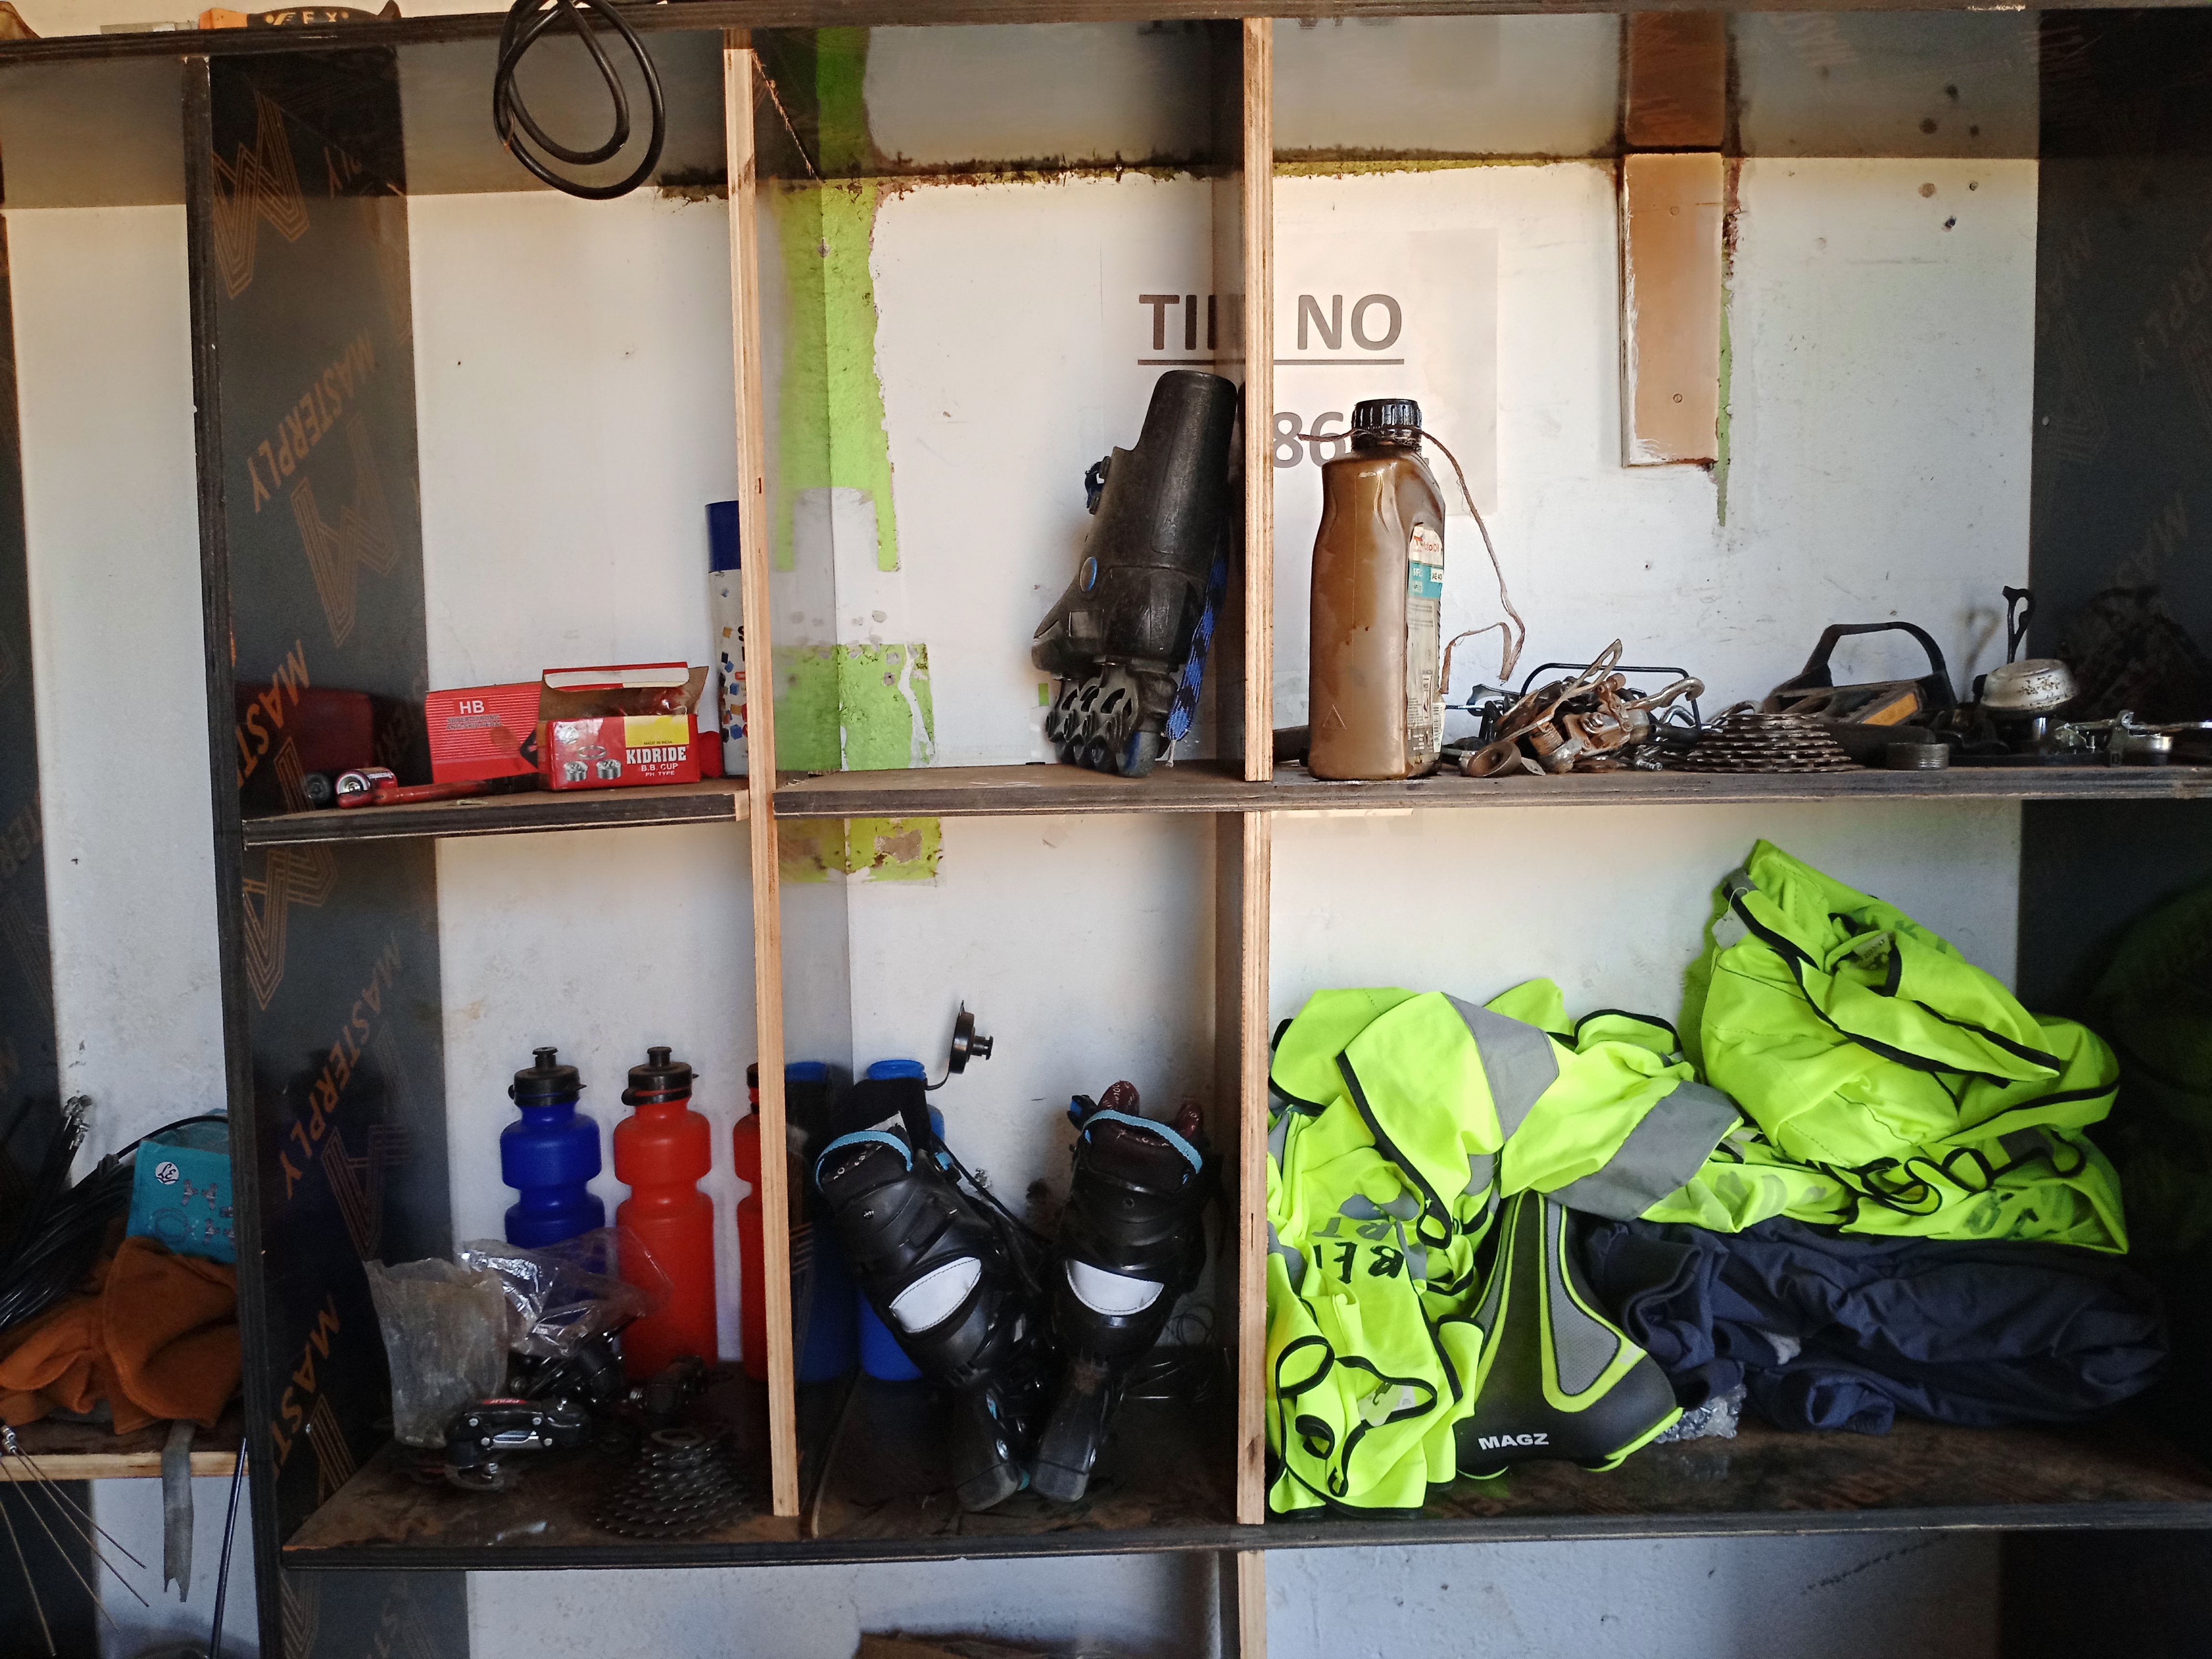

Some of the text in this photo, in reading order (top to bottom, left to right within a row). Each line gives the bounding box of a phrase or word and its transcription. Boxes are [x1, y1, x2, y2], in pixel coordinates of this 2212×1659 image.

[1297, 293, 1402, 351] NO
[246, 327, 377, 514] MASTERPLY
[236, 639, 310, 788] MAST
[459, 700, 485, 714] HB
[626, 746, 686, 764] KIDRIDE
[279, 932, 402, 1199] MASTERPLY
[272, 1294, 340, 1479] MAST
[1478, 1432, 1549, 1451] MAGZ
